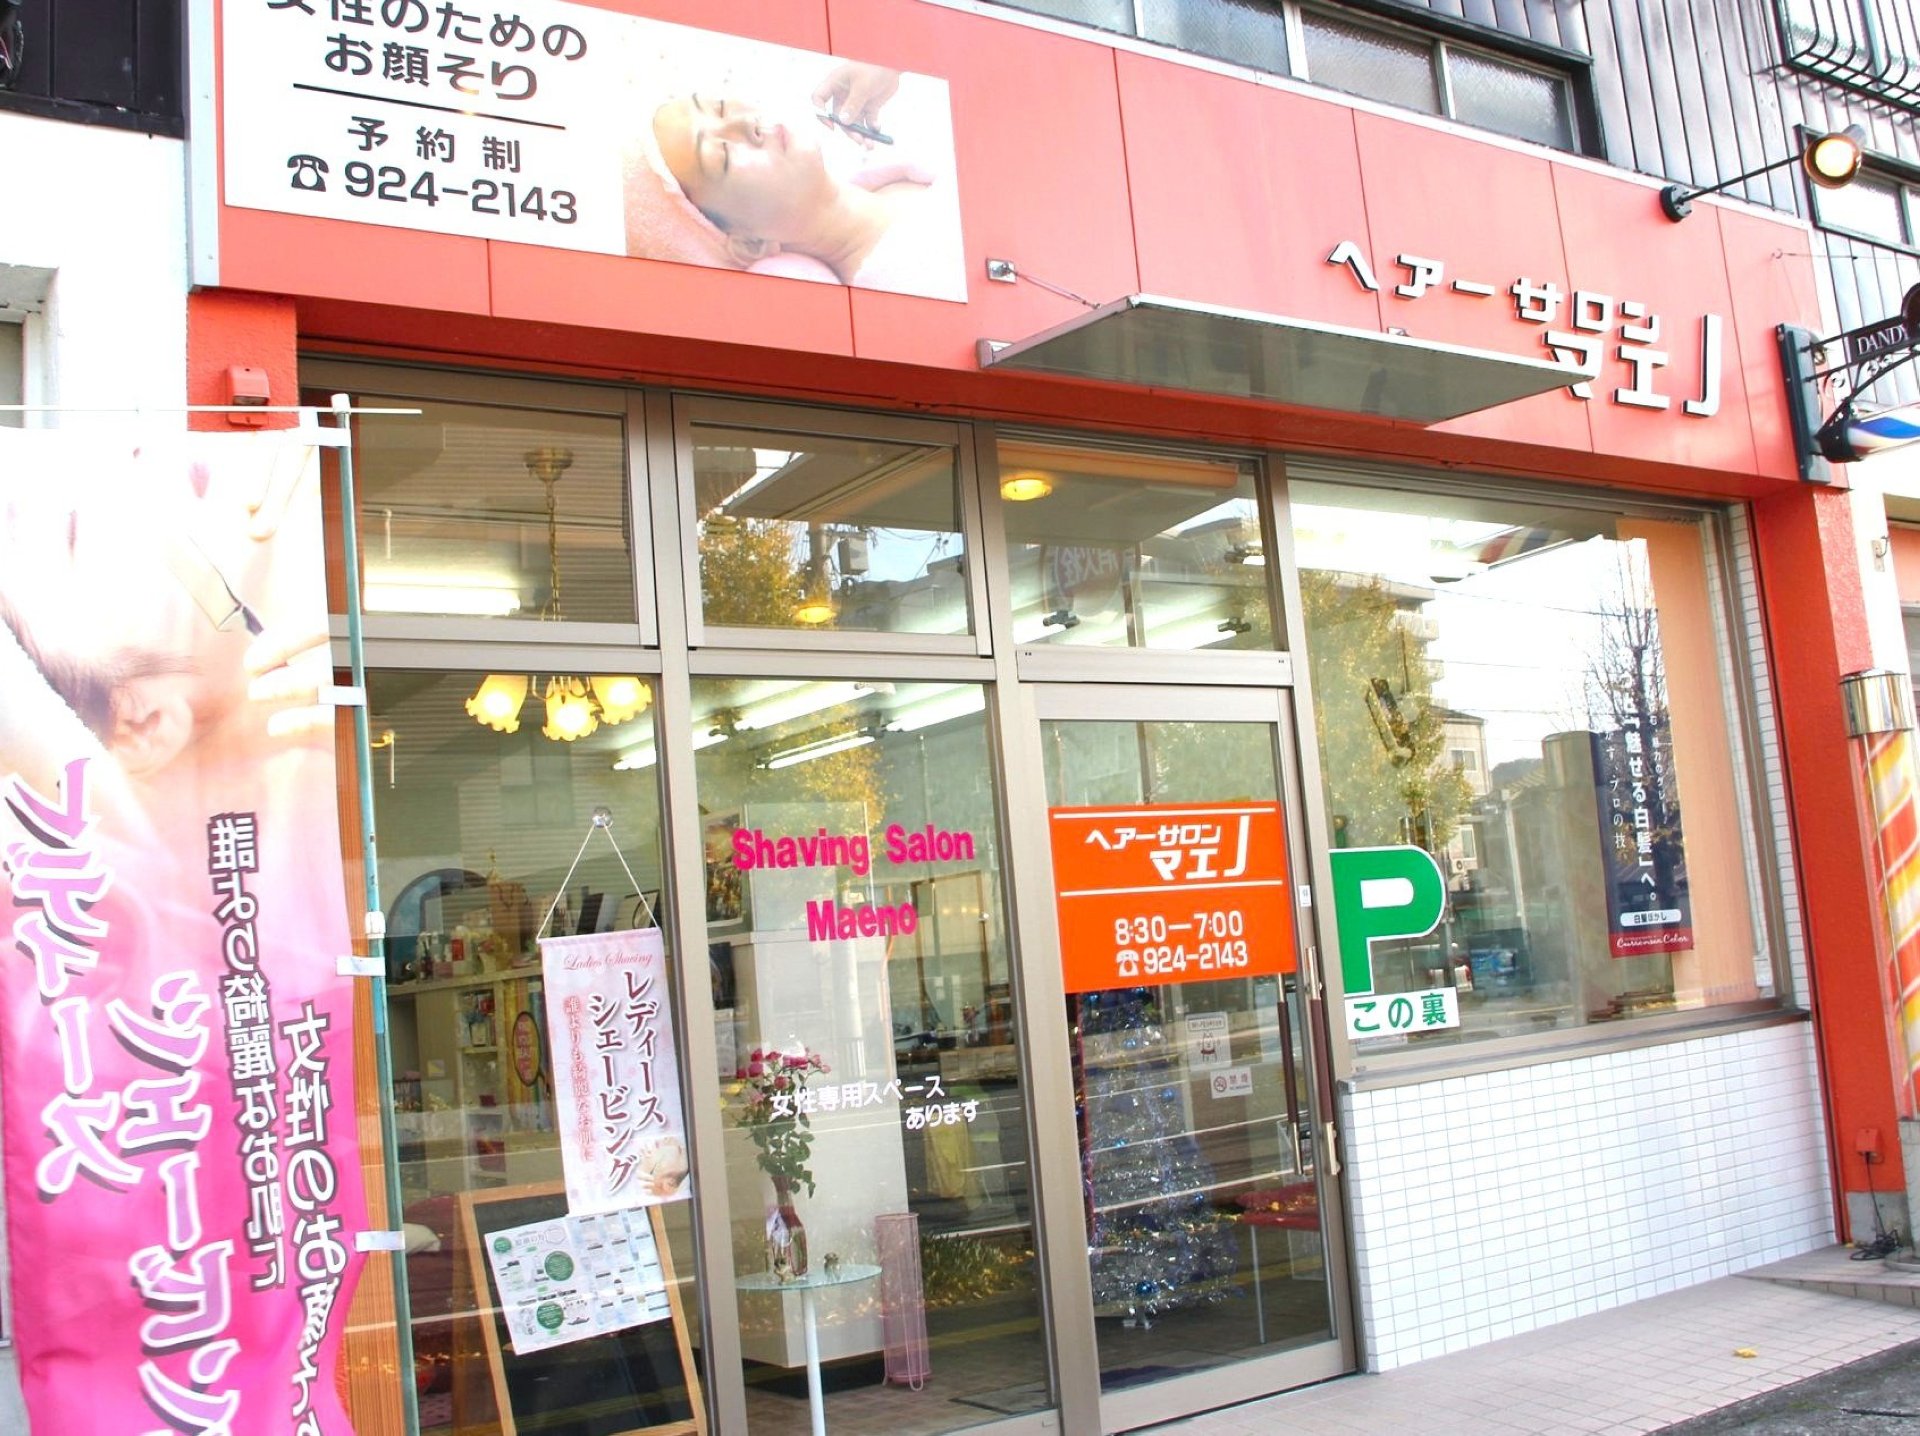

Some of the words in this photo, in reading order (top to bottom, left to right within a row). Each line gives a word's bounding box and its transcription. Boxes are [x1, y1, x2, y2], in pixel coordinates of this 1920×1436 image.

[325, 33, 538, 101] お顔そり
[347, 116, 521, 173] 予約制
[345, 161, 578, 225] 924-2143
[1326, 240, 1661, 345] ヘアーサロン
[1542, 313, 1723, 418] マエノ
[1857, 323, 1910, 356] DANDY
[732, 827, 870, 877] Shaving
[885, 823, 975, 864] Salon
[1085, 824, 1222, 851] ヘアーサロン
[1149, 815, 1251, 881] マエノ
[806, 900, 918, 942] Maeno
[1329, 845, 1446, 997] P
[1143, 941, 1249, 976] 924-2143
[1353, 993, 1448, 1033] この裏
[623, 970, 666, 1131] レディース
[588, 994, 638, 1192] シェービング
[769, 1075, 946, 1118] 女性専用スペース
[905, 1098, 980, 1131] あります
